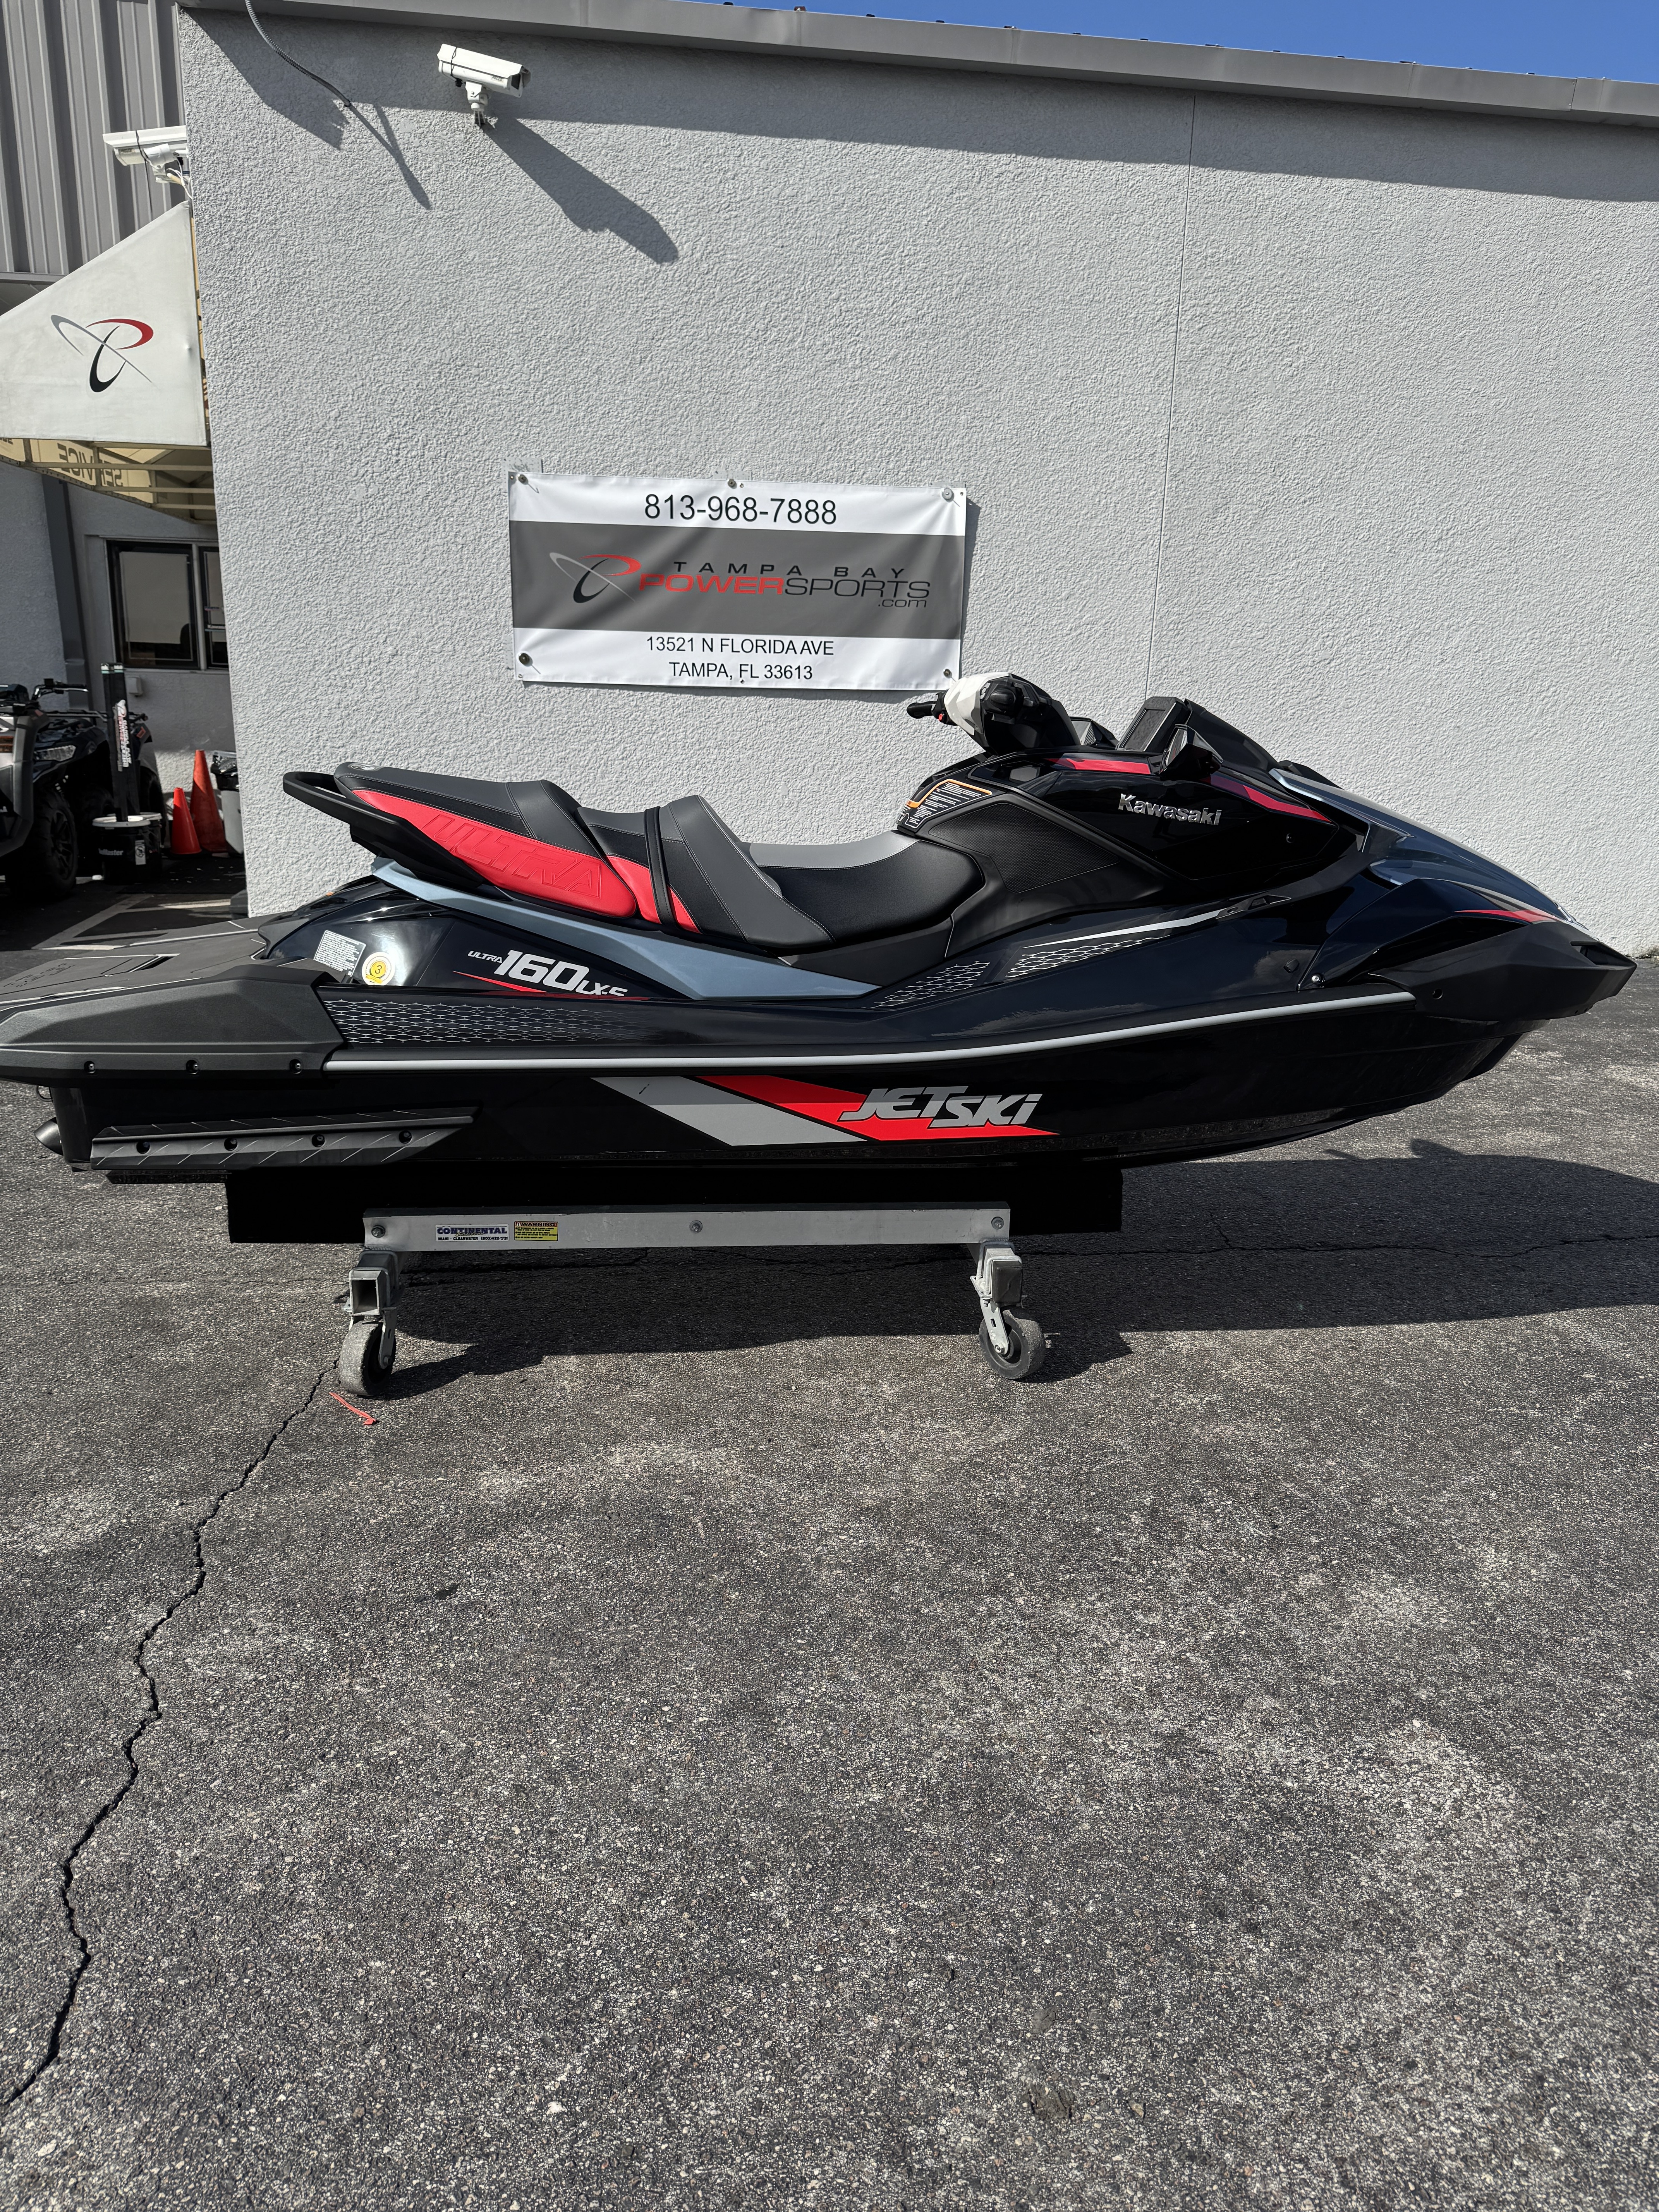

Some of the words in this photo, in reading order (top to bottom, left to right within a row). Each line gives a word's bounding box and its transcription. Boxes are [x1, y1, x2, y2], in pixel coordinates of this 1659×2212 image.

[644, 494, 836, 525] 813-968-7888
[674, 562, 802, 576] TAMPA
[834, 567, 905, 579] BAY
[639, 574, 931, 599] POWERSPORTS
[878, 599, 927, 608] .com
[646, 636, 694, 652] 13521
[702, 638, 713, 652] N
[720, 638, 797, 654] FLORIDA
[800, 641, 834, 655] AVE
[669, 662, 733, 680] TAMPA,
[739, 664, 759, 678] FL
[764, 665, 813, 680] 33613
[1118, 793, 1222, 826] Kawasaki
[421, 814, 602, 900] ULTRA
[467, 950, 503, 964] ULTRA
[374, 965, 382, 974] 3
[839, 1086, 969, 1121] JET
